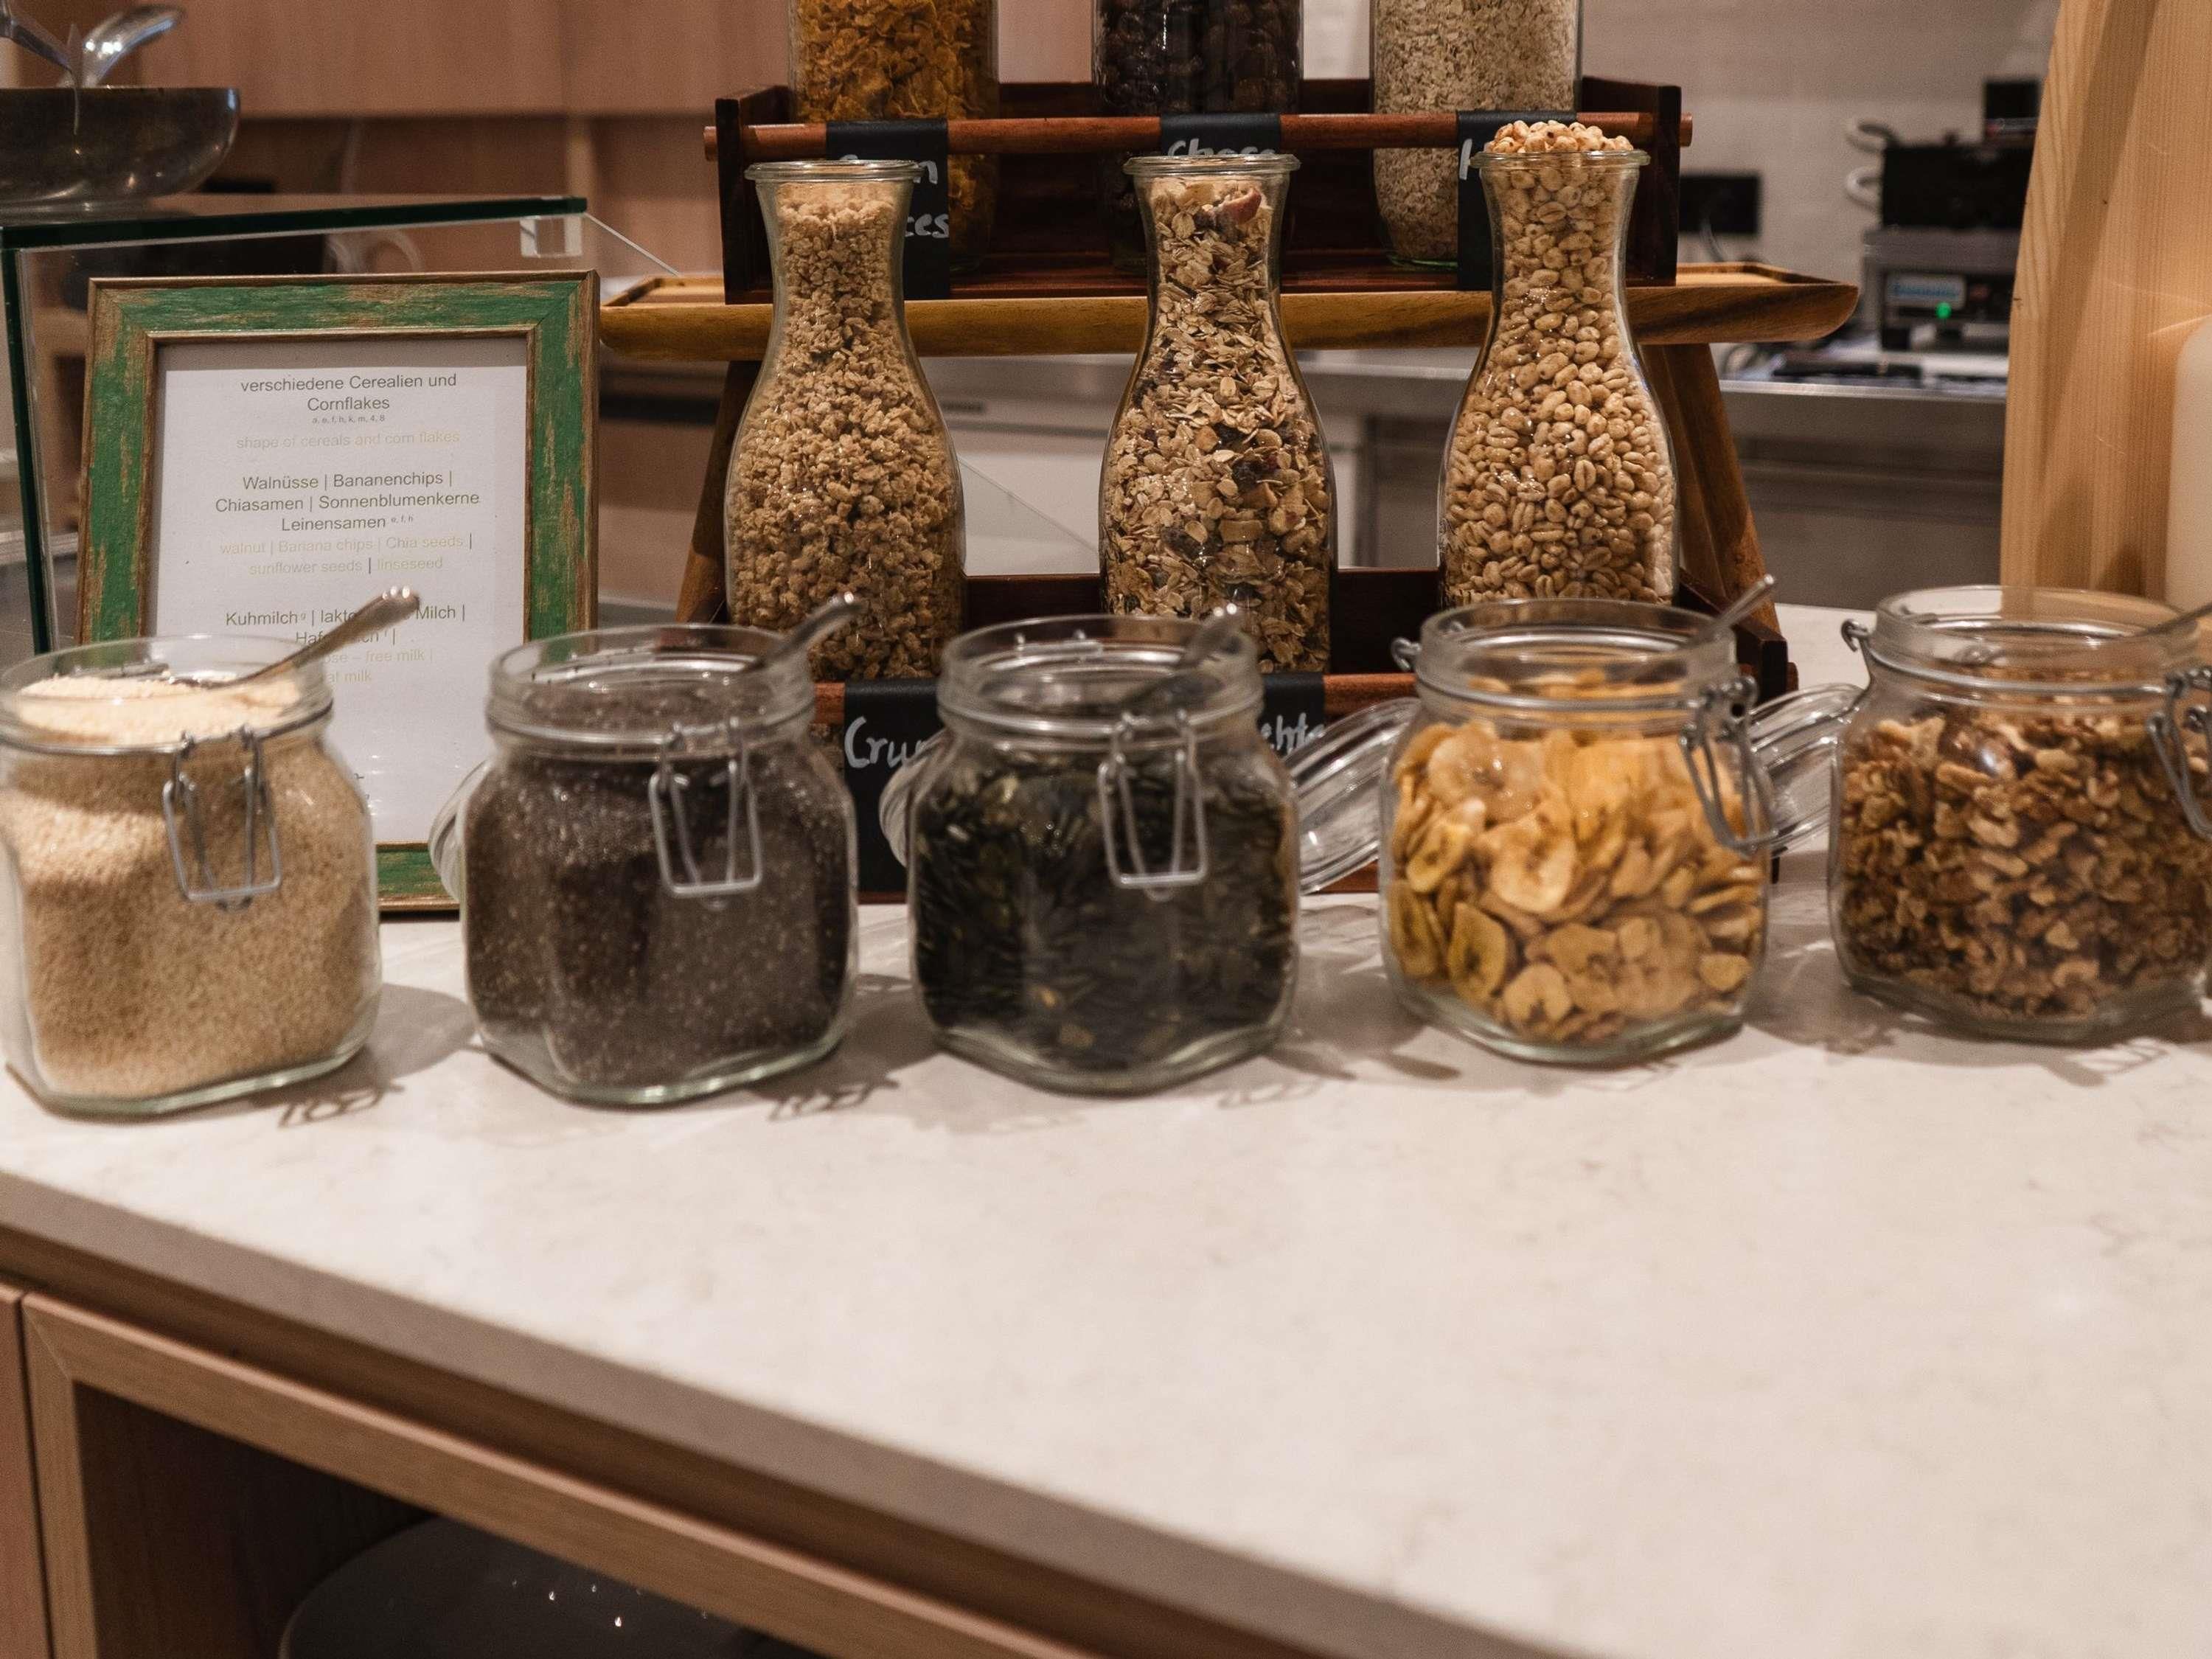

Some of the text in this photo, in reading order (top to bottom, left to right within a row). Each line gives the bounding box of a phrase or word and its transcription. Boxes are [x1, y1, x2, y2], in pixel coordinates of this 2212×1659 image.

[240, 373, 456, 392] verschiedene Cerealien und
[307, 397, 390, 411] Cornflakes
[301, 434, 350, 447] cereals
[354, 434, 380, 445] and
[419, 430, 460, 442] flakes
[243, 476, 319, 490] Walnüsse
[333, 472, 443, 488] Bananenchips
[215, 498, 304, 512] Chiasamen
[319, 492, 479, 509] Sonnenblumenkerne
[282, 517, 386, 531] Leinensamen
[220, 542, 265, 555] walnut
[278, 540, 331, 553] Banana
[336, 539, 373, 554] chips
[386, 536, 417, 549] Chia
[422, 534, 463, 548] seeds
[248, 559, 316, 575] sunflower
[321, 557, 362, 571] seeds
[226, 611, 298, 626] Kuhmilch
[416, 605, 456, 619] Milch
[365, 650, 392, 662] free
[397, 647, 425, 661] milk
